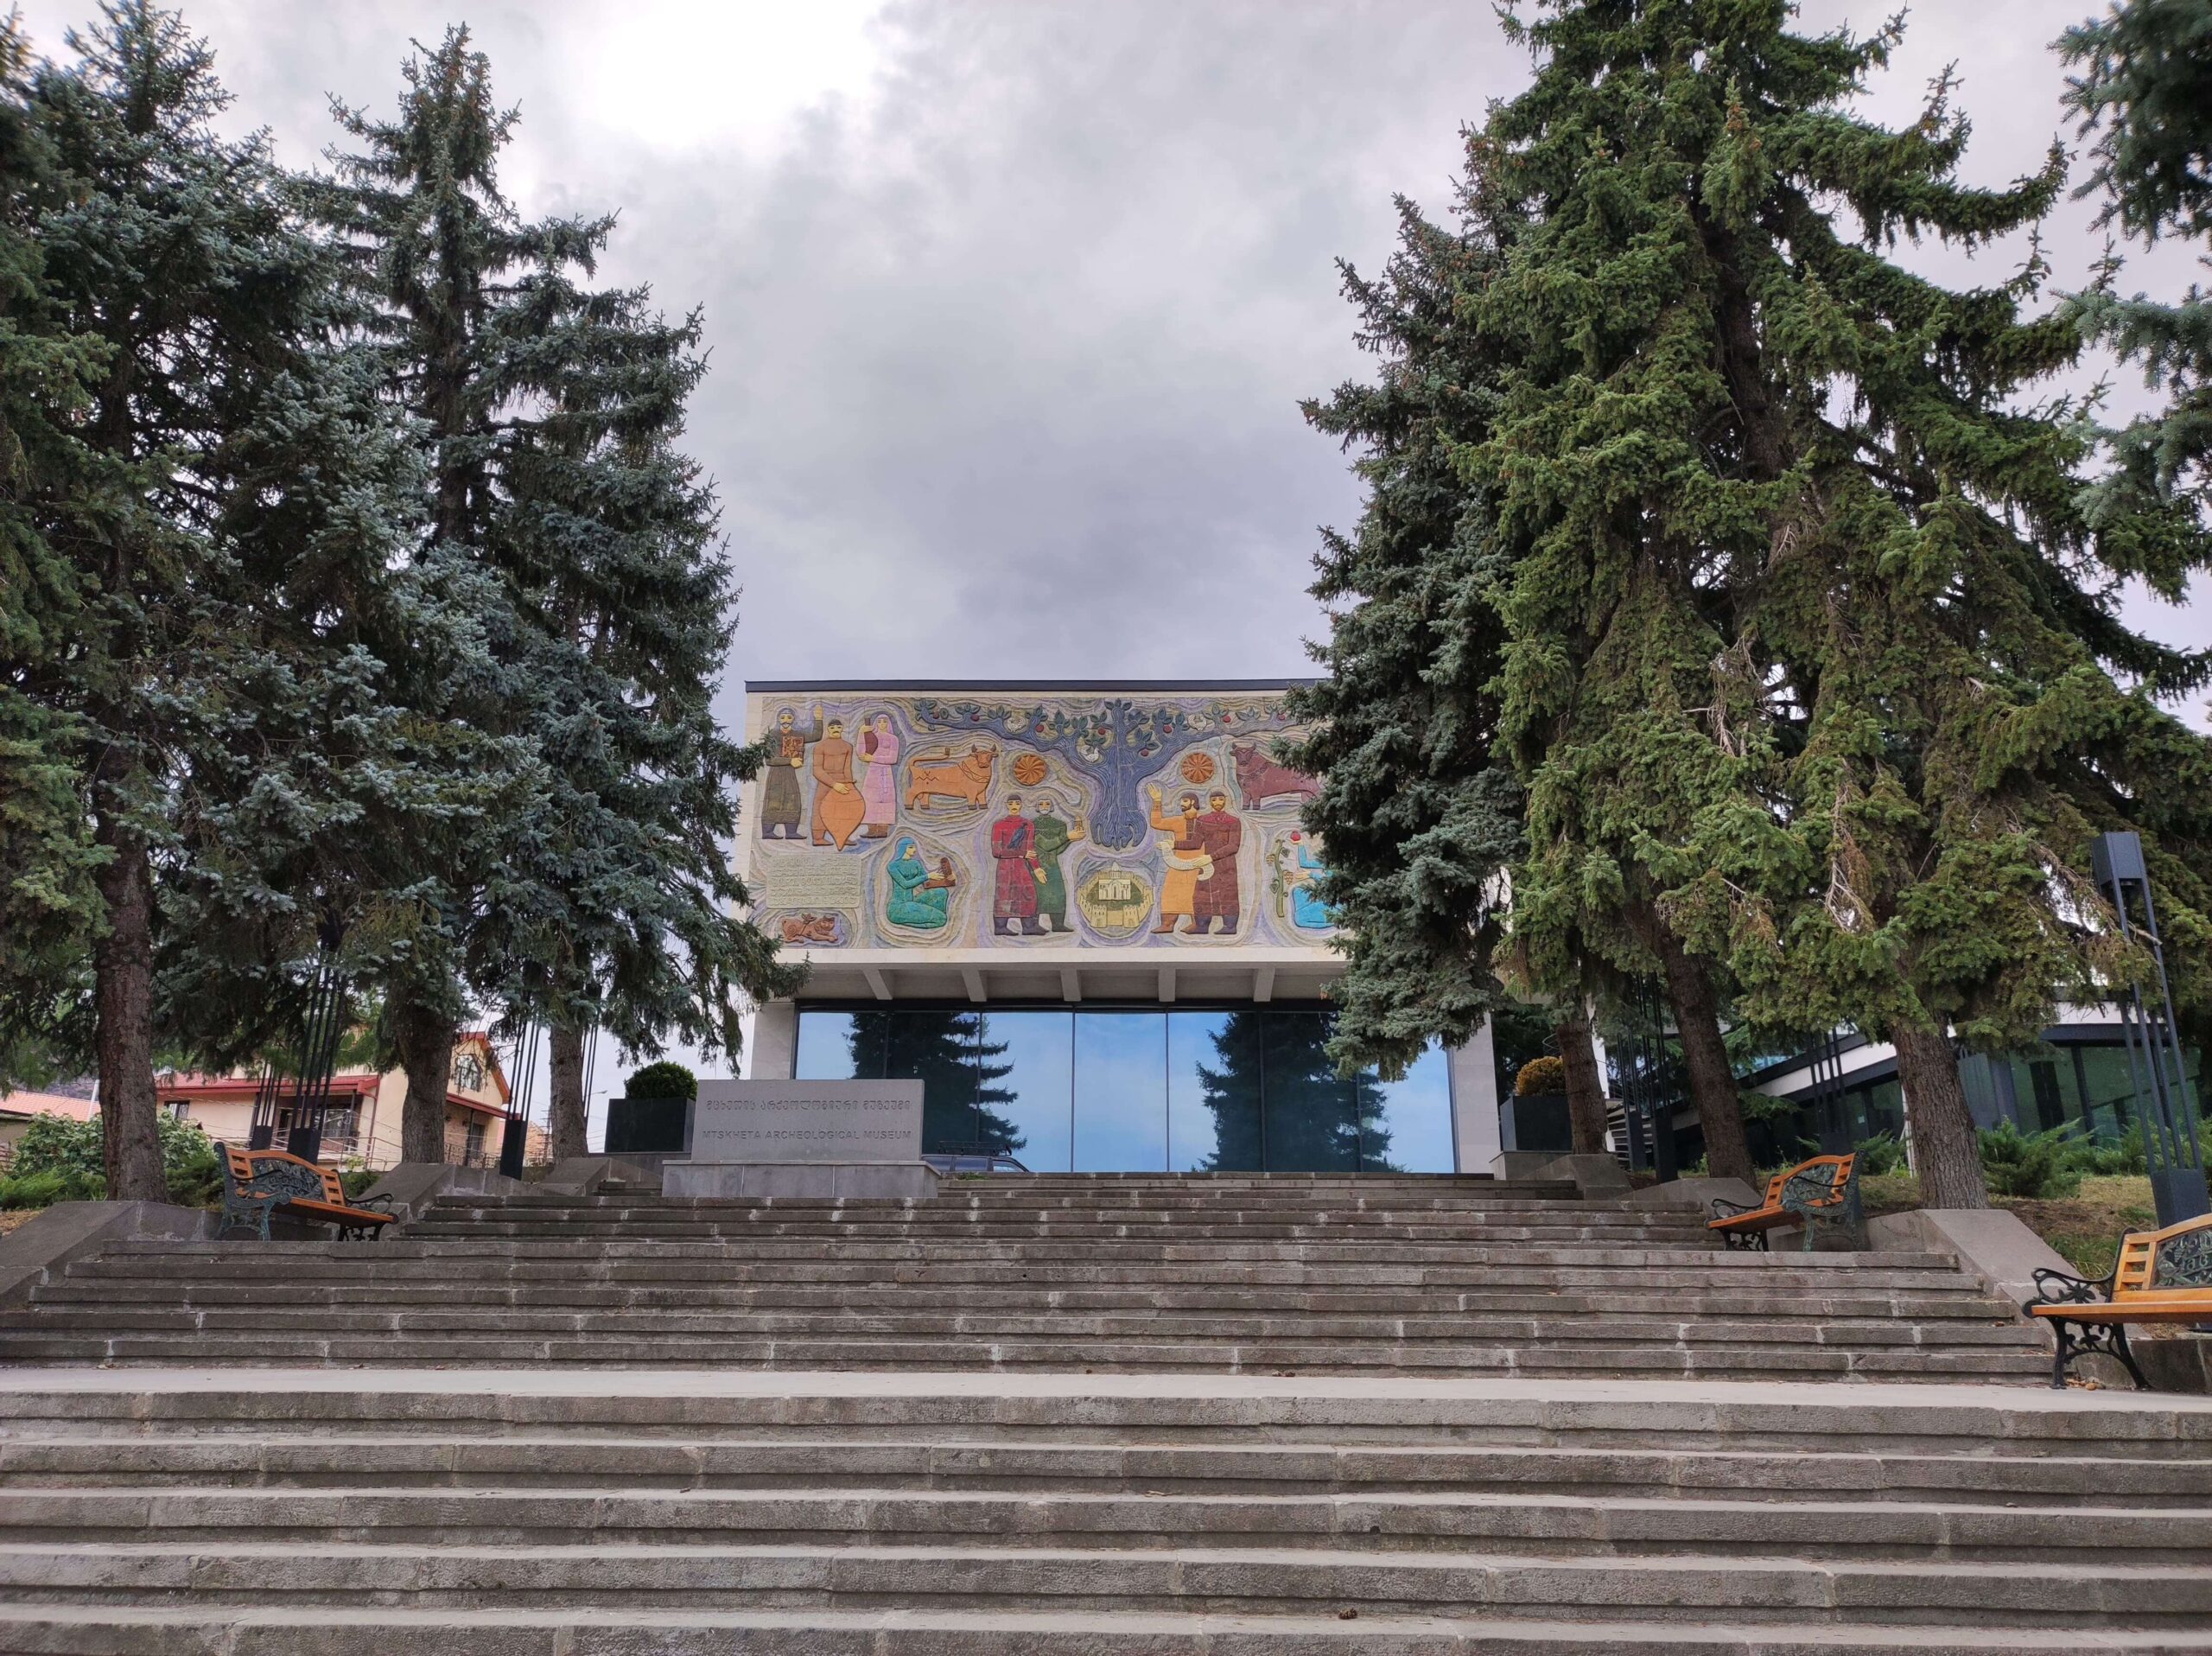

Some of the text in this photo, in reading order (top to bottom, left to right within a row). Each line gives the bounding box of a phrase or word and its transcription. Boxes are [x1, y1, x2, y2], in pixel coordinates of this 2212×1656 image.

[702, 1130, 912, 1140] MTSKHETA ARCHEOLOGICAL MUSEUM
